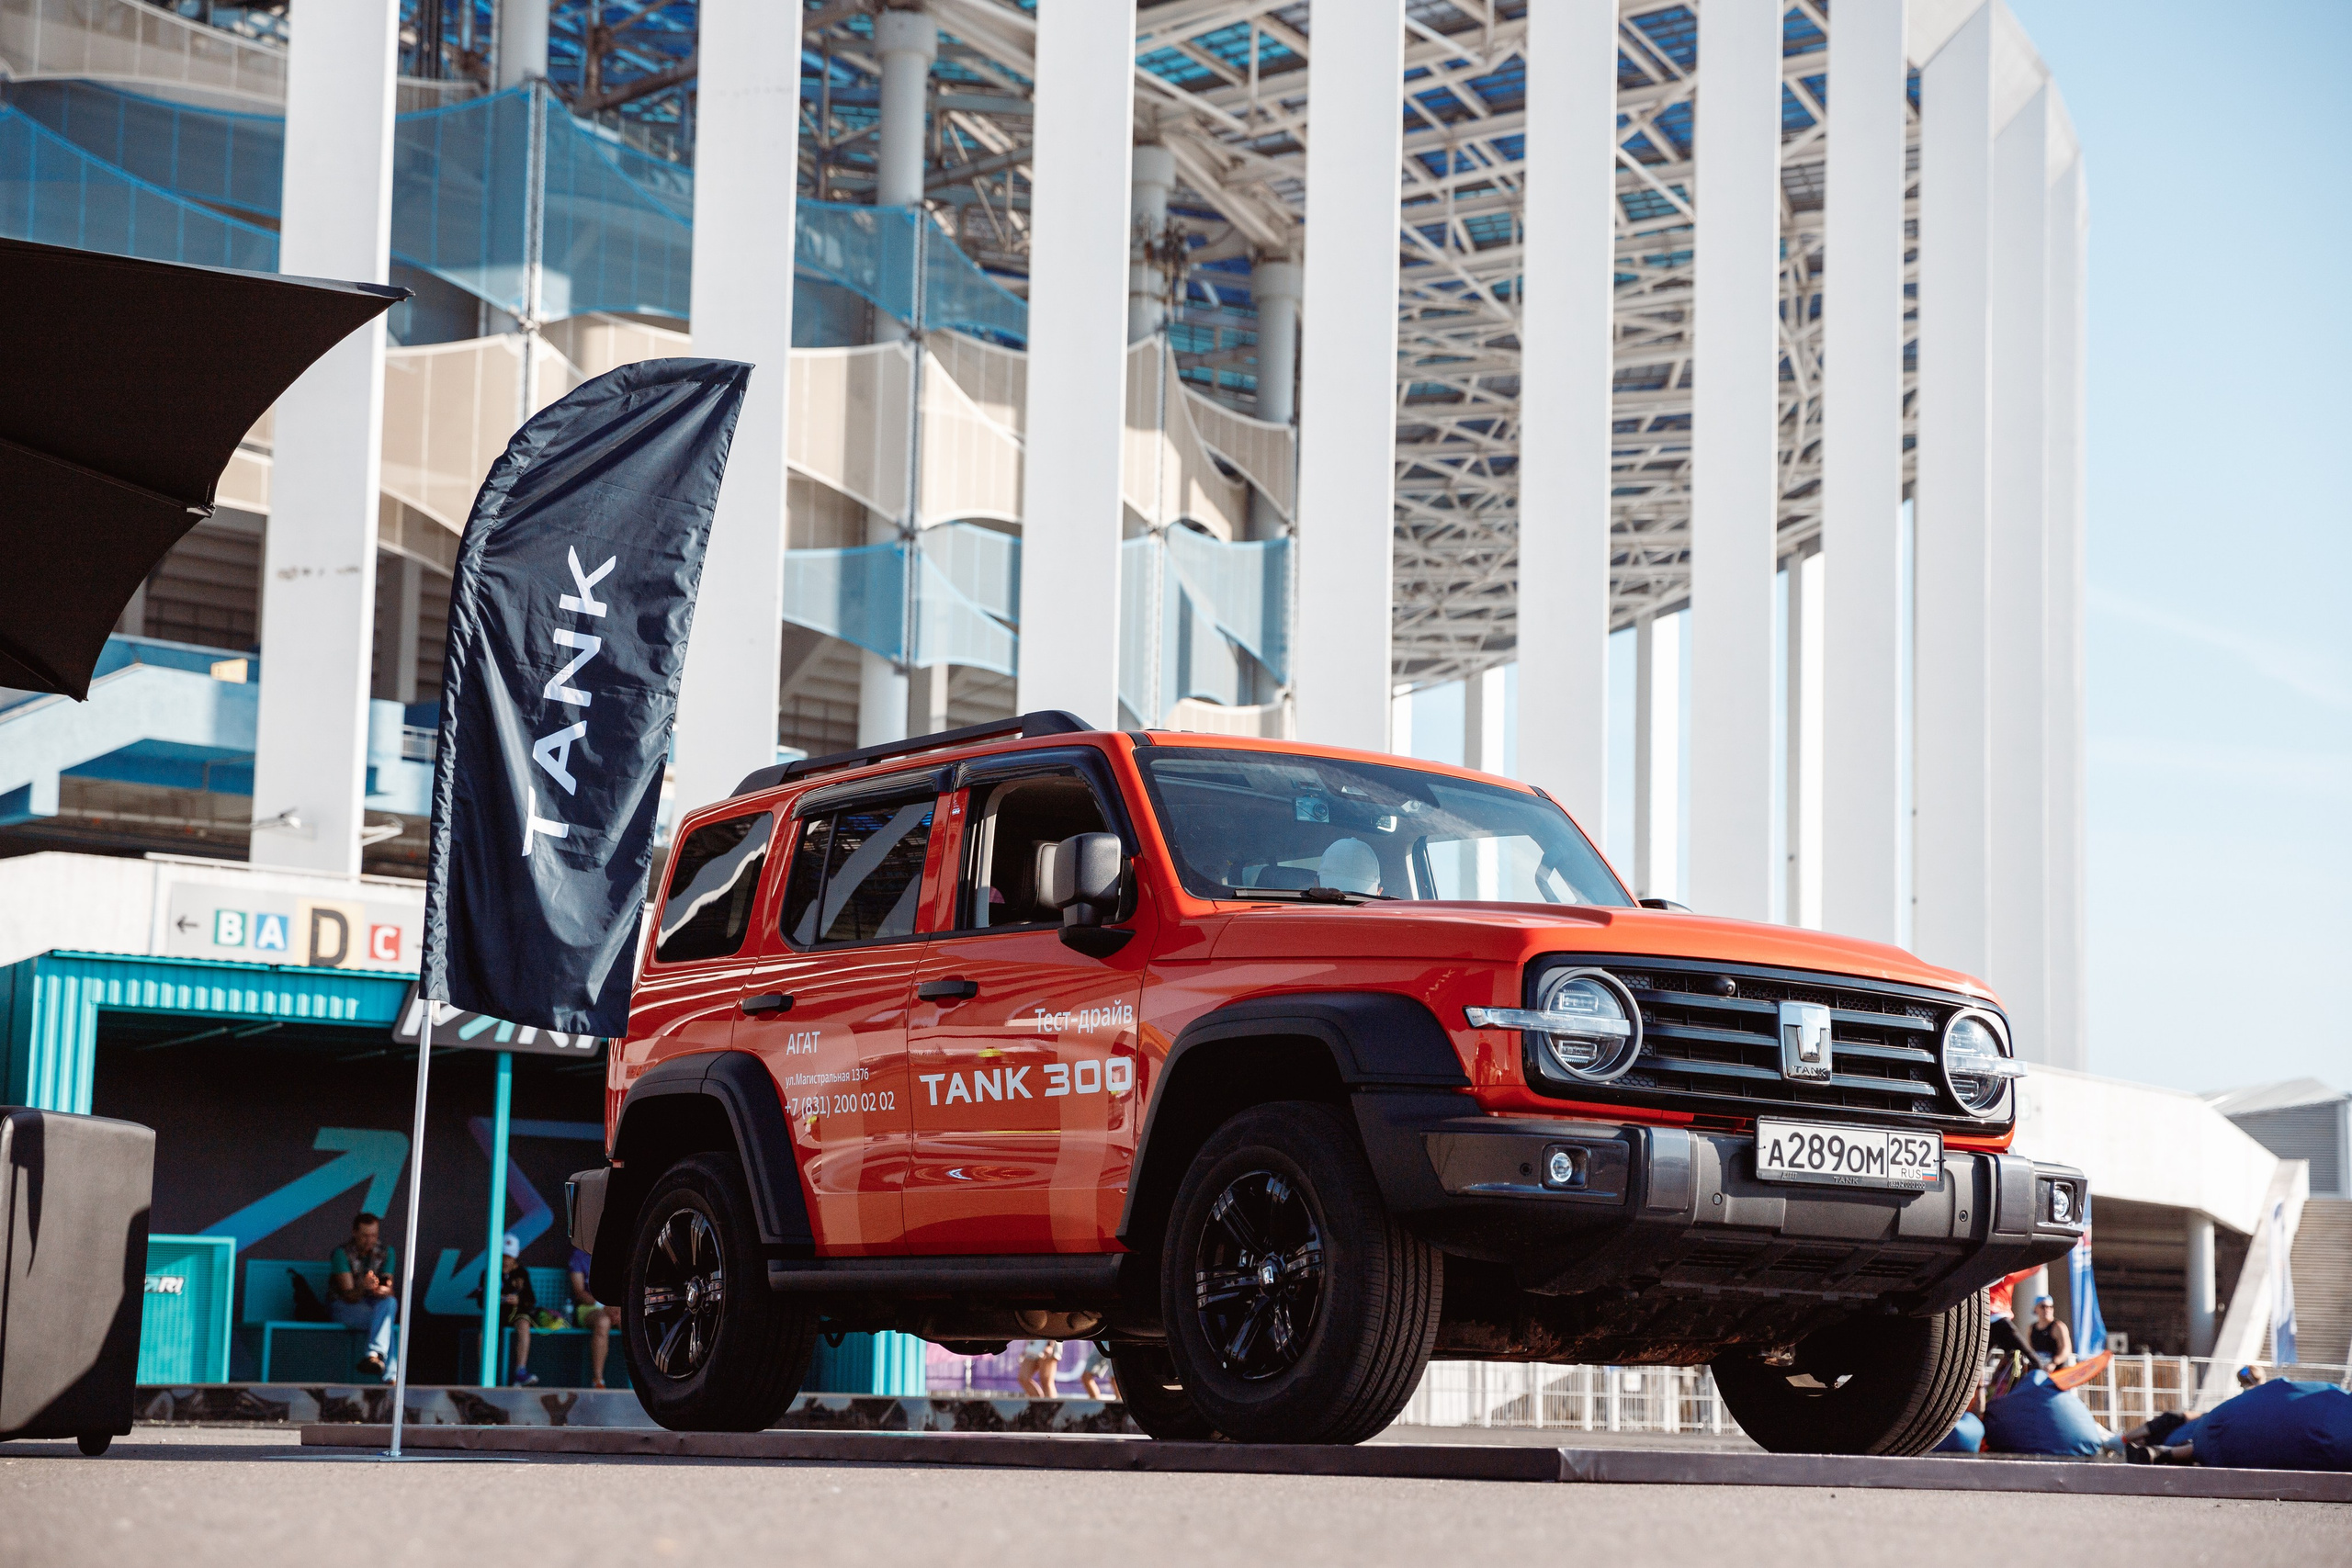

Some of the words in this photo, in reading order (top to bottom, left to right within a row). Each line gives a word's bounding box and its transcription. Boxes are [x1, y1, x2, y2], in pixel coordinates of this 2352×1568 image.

[522, 545, 616, 856] TANK
[218, 910, 243, 945] B
[258, 915, 287, 950] A
[309, 907, 349, 967] D
[374, 926, 399, 960] C
[1035, 999, 1133, 1033] Тест-драйв
[786, 1031, 820, 1055] АГАТ
[919, 1066, 1033, 1106] TANK
[1043, 1056, 1133, 1097] 300
[1792, 1066, 1827, 1077] TANK
[785, 1098, 798, 1116] +7
[801, 1095, 831, 1120] (831)
[833, 1093, 857, 1113] 200
[860, 1092, 876, 1111] 02
[879, 1090, 895, 1111] 02
[1890, 1137, 1931, 1168] 252
[1833, 1176, 1859, 1185] TANK
[1901, 1168, 1922, 1179] RUS
